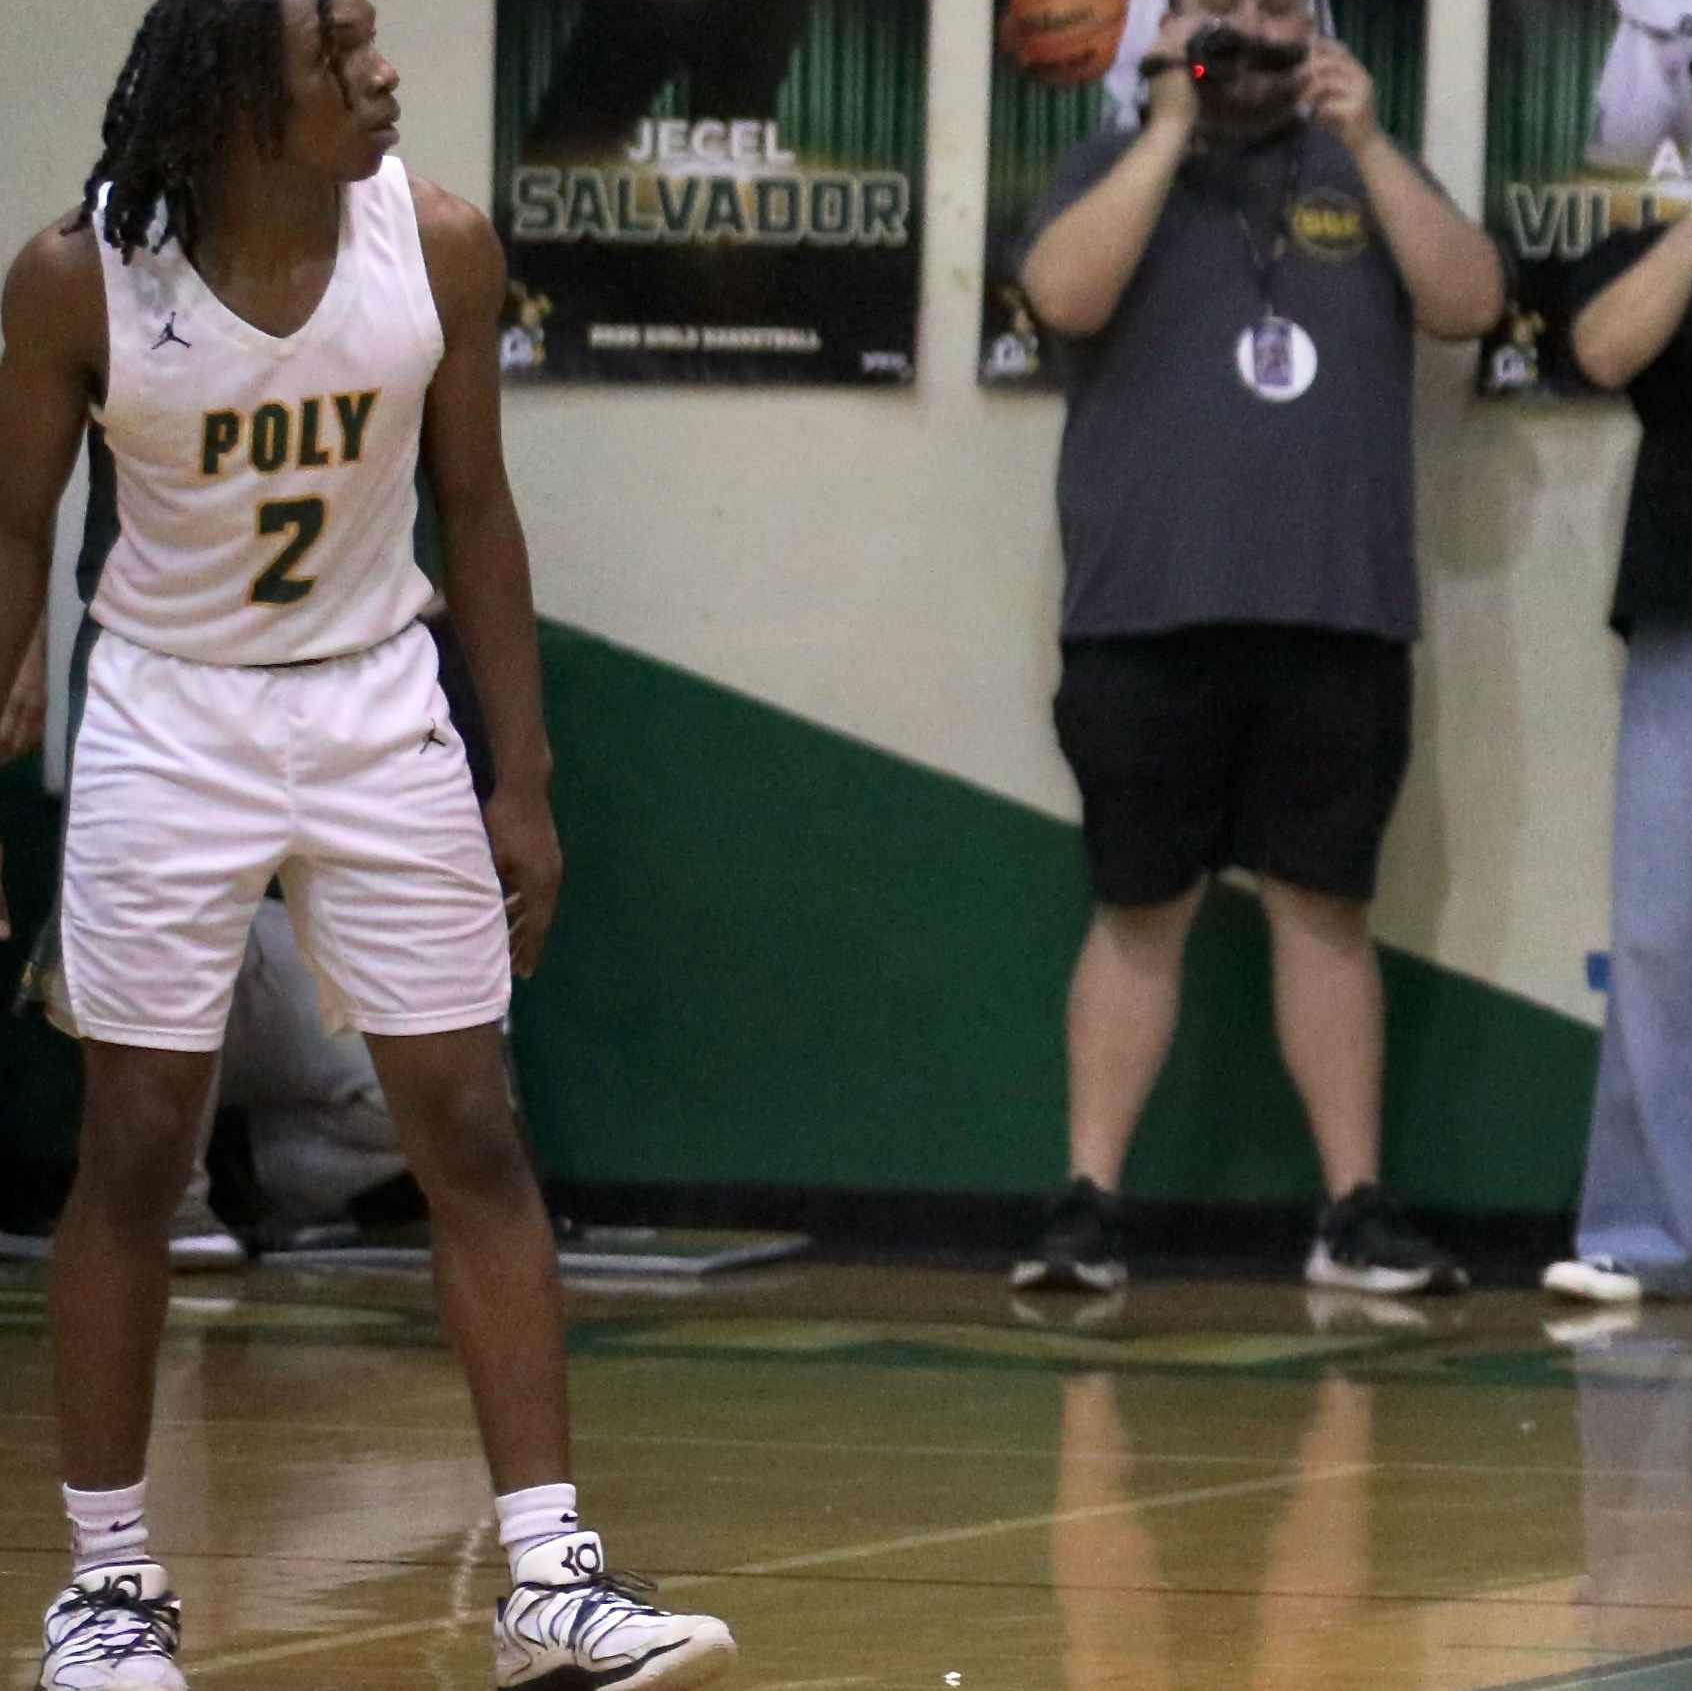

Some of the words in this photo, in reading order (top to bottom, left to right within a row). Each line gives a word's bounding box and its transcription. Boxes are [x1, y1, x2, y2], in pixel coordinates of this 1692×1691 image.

[511, 166, 910, 247] SALVADOR
[201, 390, 381, 480] POLY
[249, 494, 330, 607] 2
